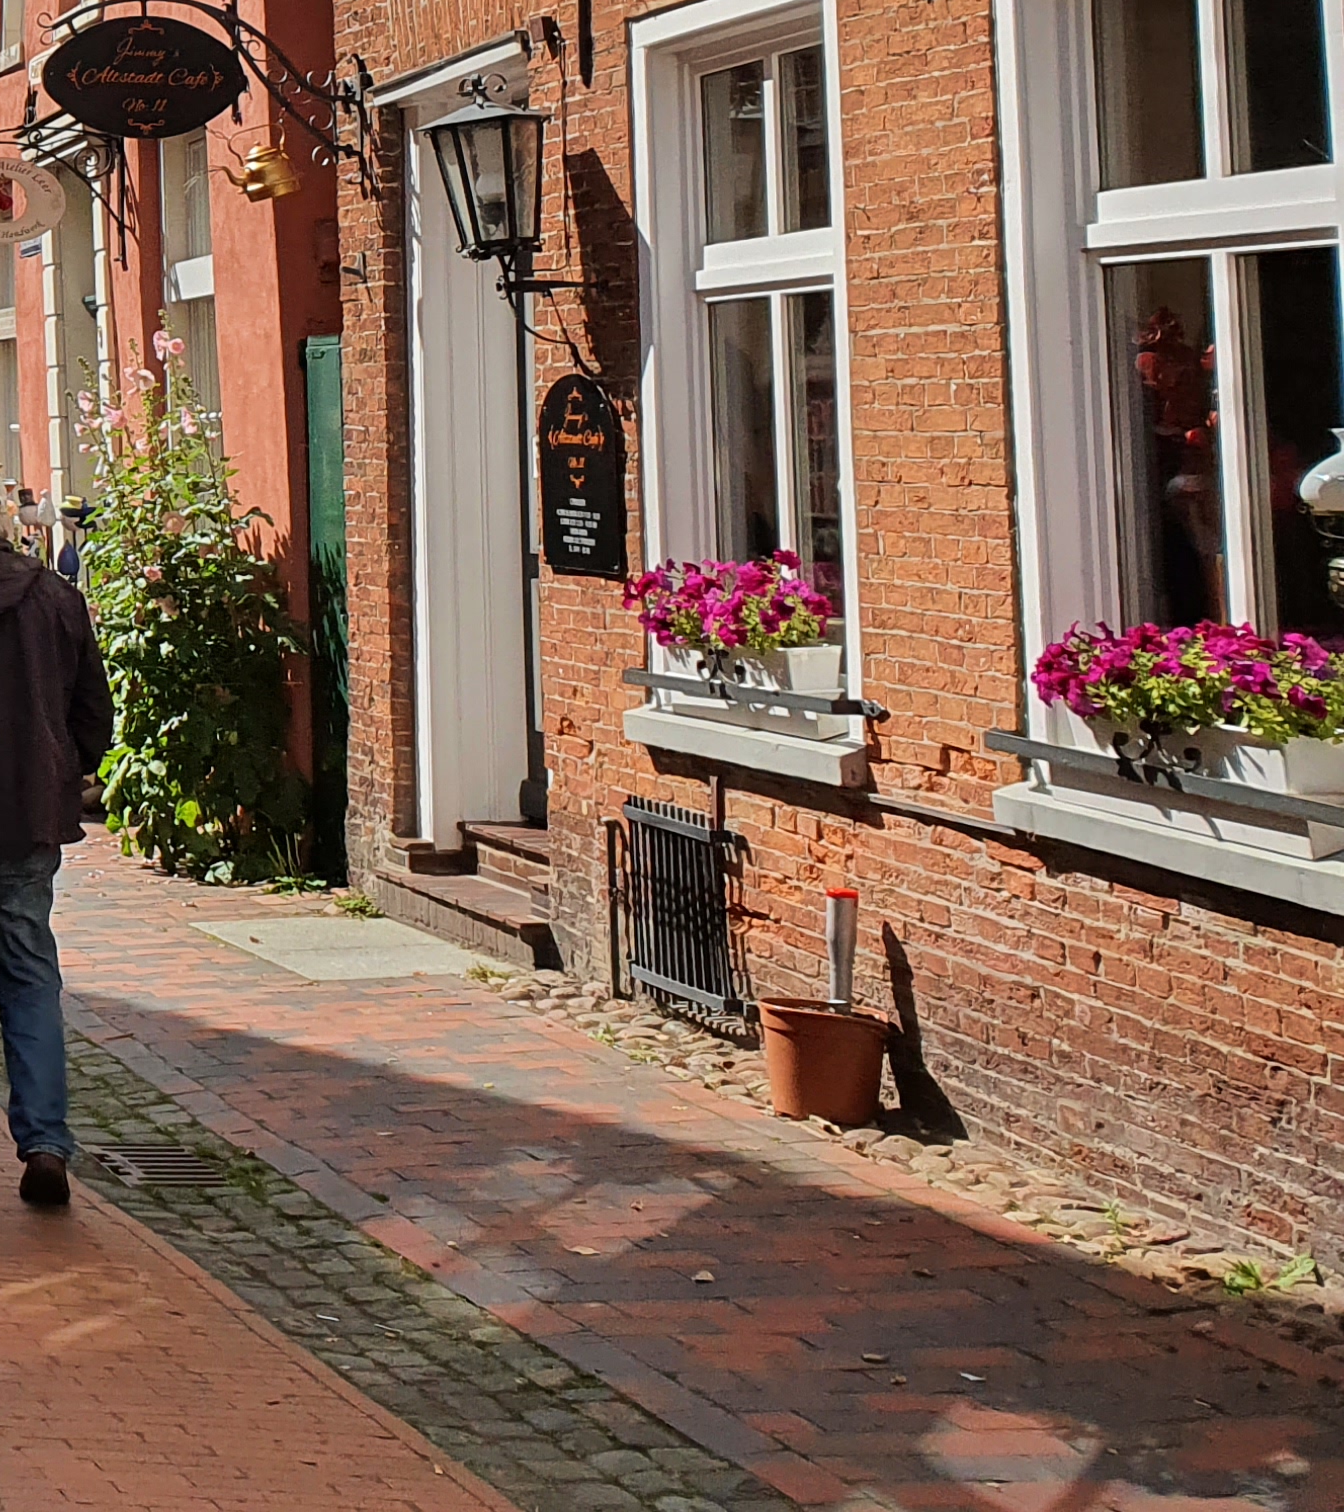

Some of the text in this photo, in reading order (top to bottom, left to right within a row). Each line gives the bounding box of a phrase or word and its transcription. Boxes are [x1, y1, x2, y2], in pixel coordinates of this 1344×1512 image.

[82, 66, 163, 85] Altstadt
[0, 161, 32, 176] Atelier
[32, 172, 52, 194] Leer
